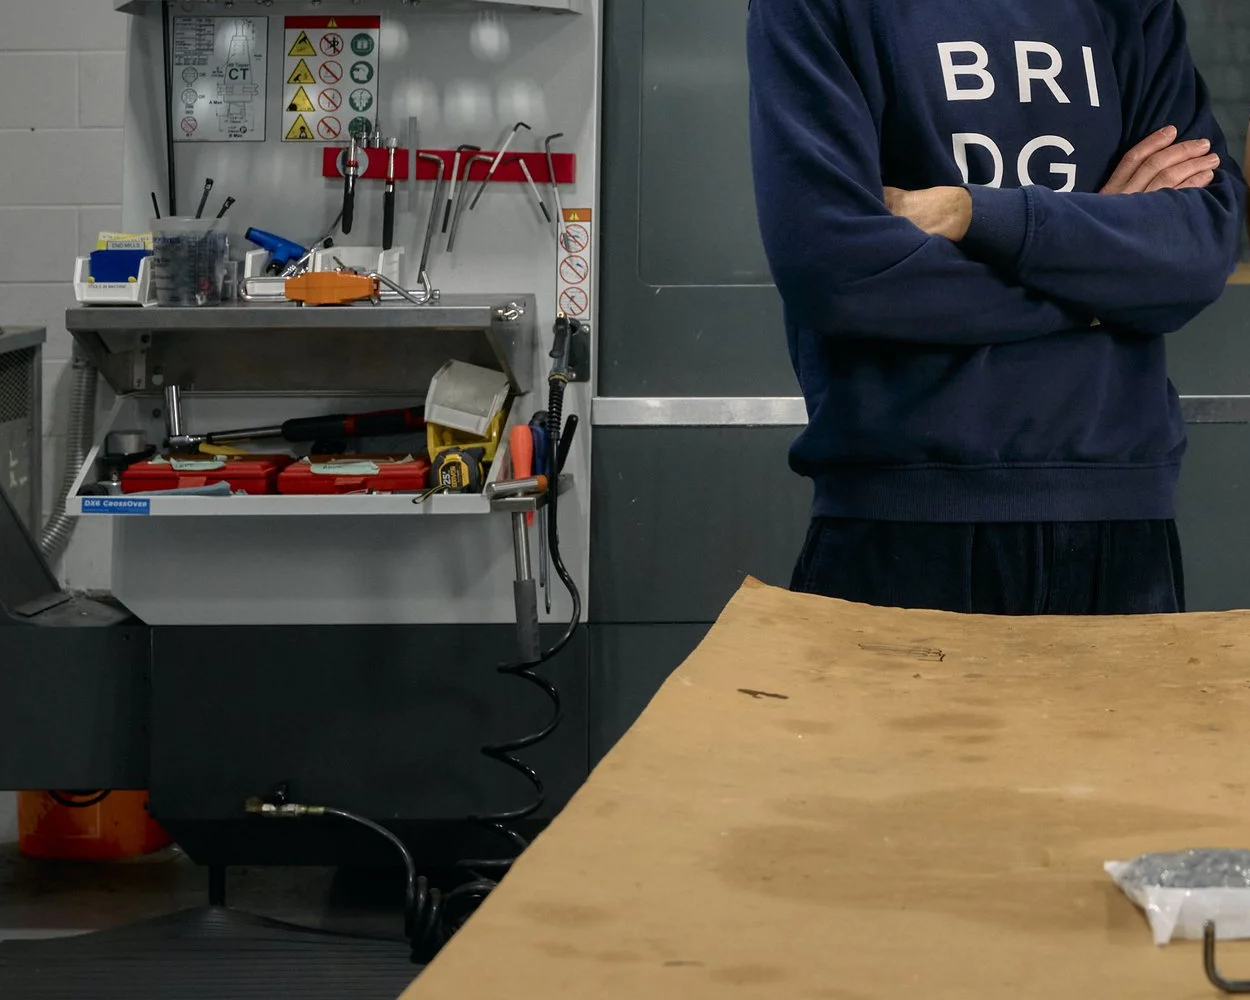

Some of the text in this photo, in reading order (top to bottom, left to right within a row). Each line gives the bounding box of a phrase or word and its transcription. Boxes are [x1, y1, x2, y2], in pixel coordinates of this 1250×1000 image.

[228, 68, 249, 80] CT
[937, 41, 1100, 107] BRI
[952, 133, 1077, 193] DG
